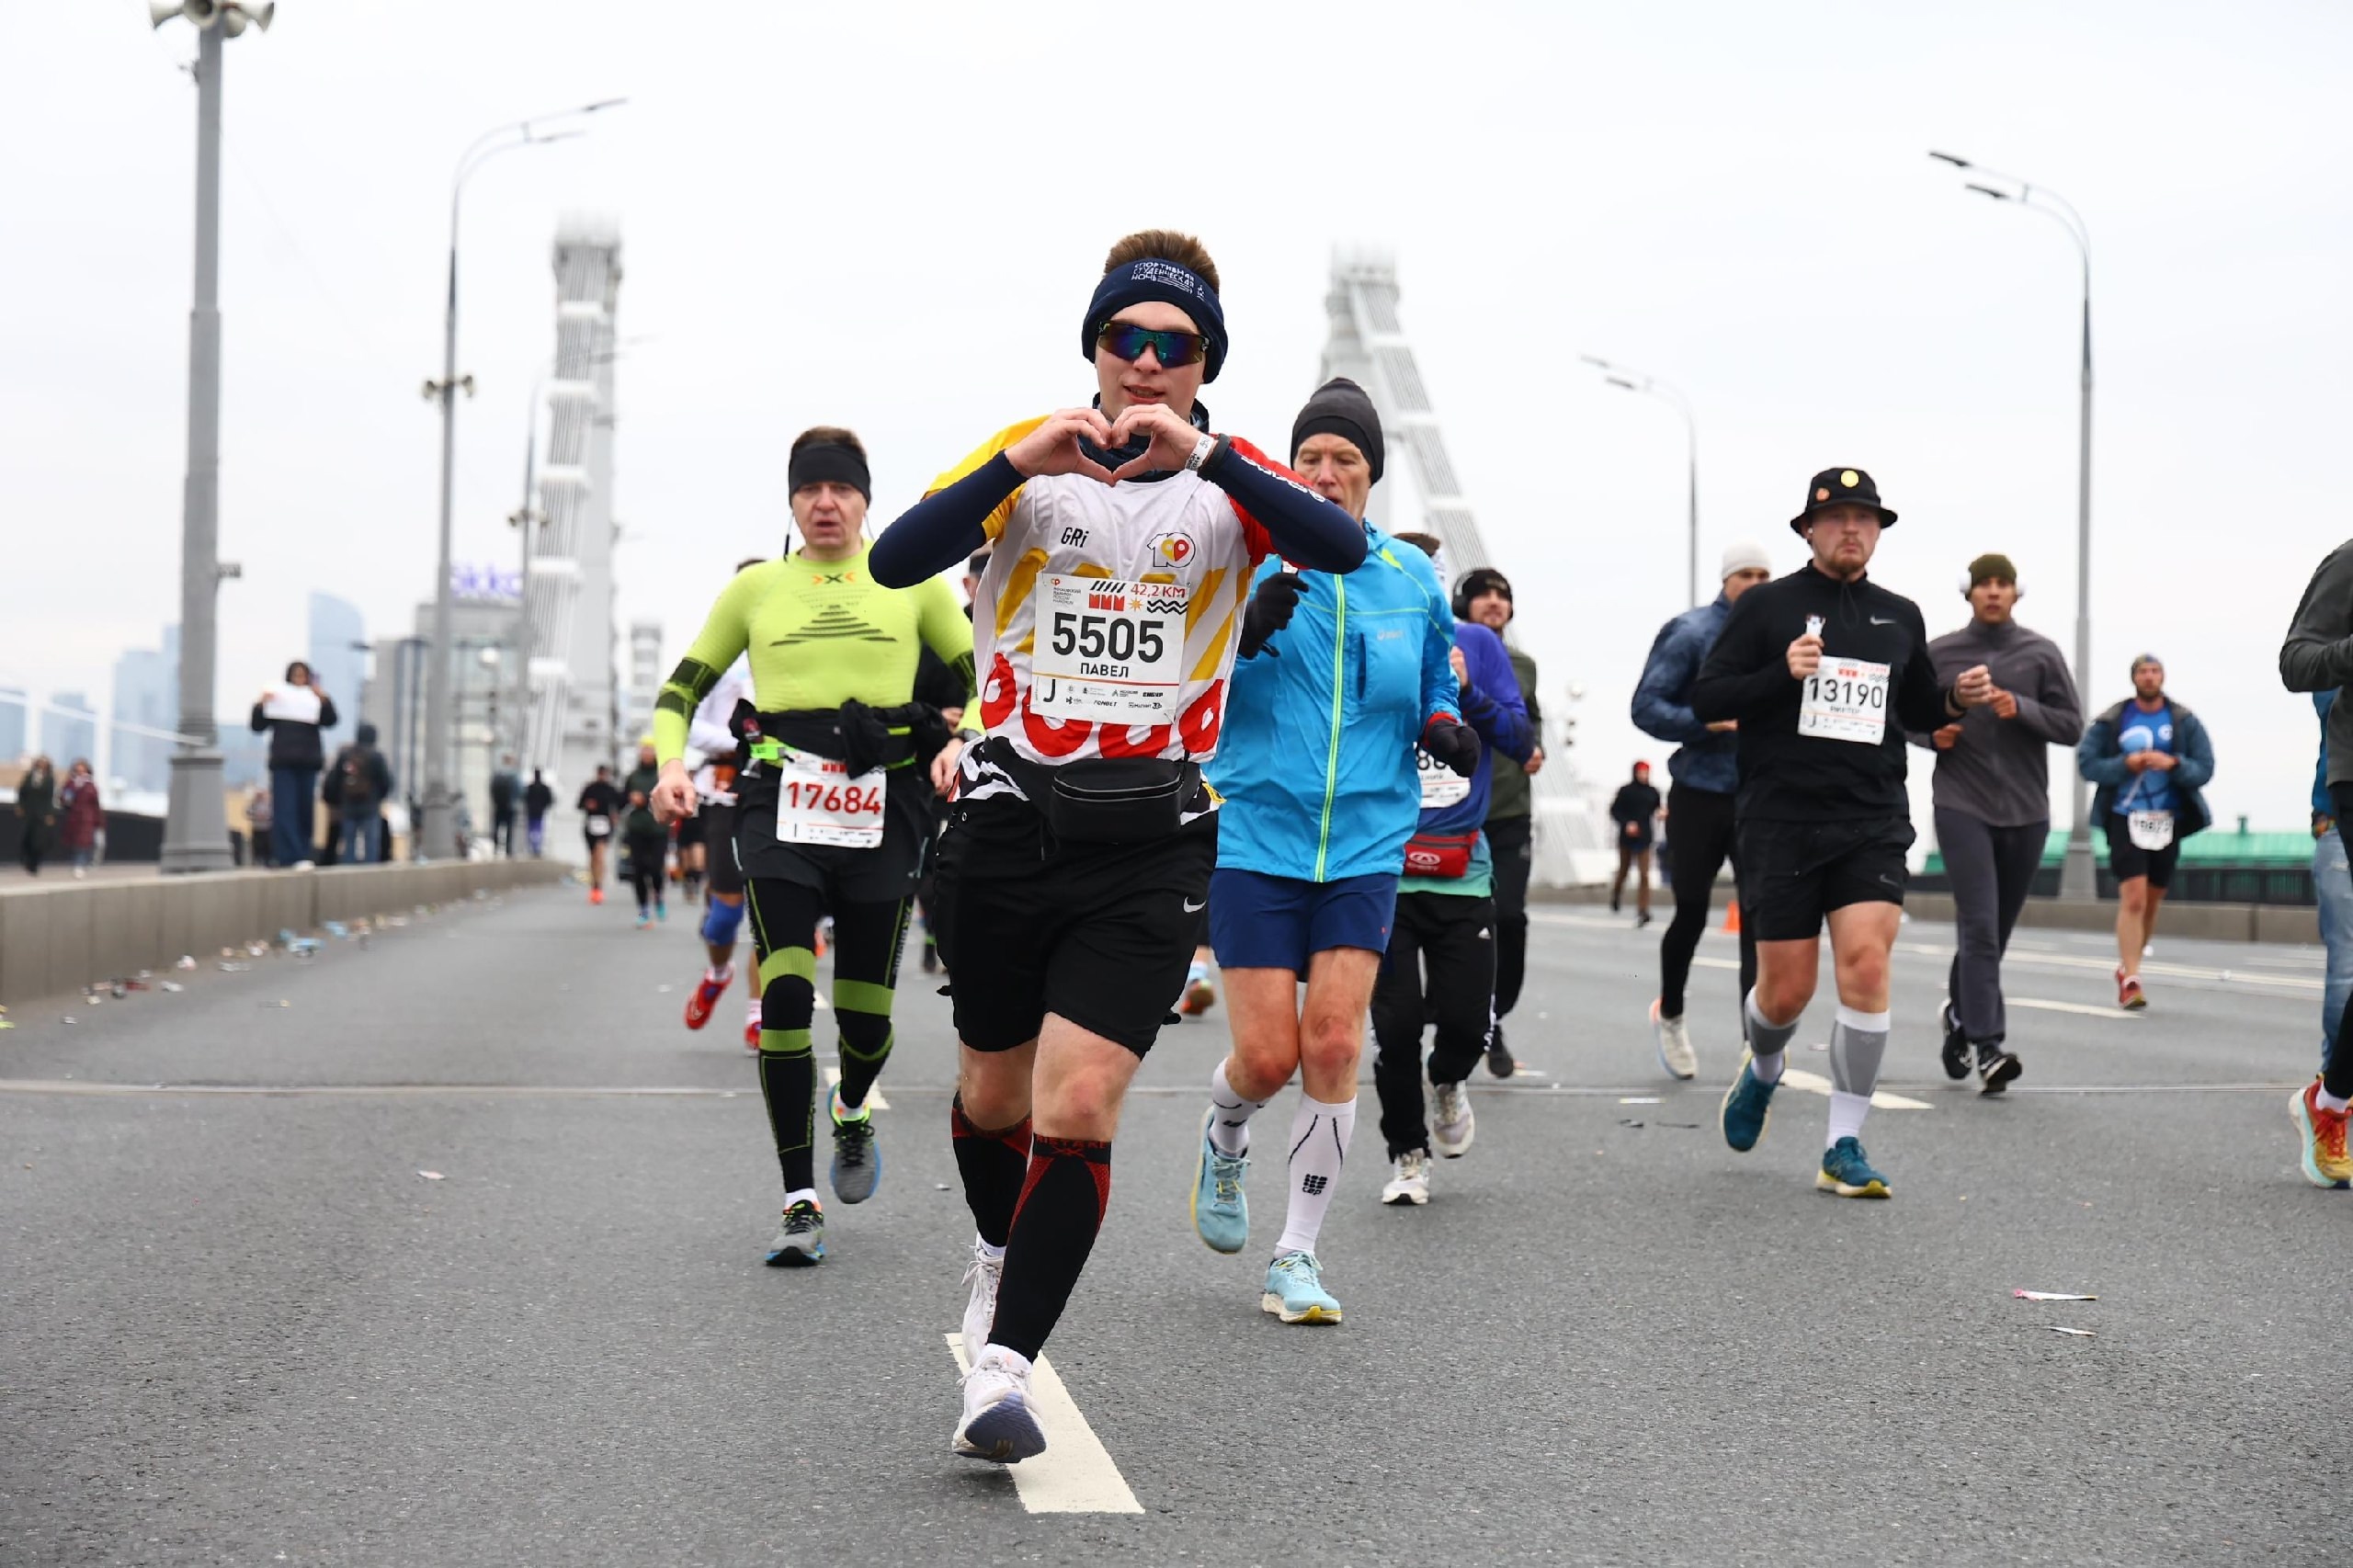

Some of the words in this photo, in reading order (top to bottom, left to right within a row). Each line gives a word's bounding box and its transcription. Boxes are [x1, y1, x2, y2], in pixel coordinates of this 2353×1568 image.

[1133, 267, 1194, 288] СТУДЕНЧЕСКАЯ
[1134, 262, 1194, 281] СПОРТИВНАЯ
[1052, 612, 1164, 663] 5505
[1080, 663, 1129, 677] ПАВЕЛ
[1043, 679, 1056, 702] J
[1809, 678, 1882, 709] 13190
[788, 781, 881, 814] 17684
